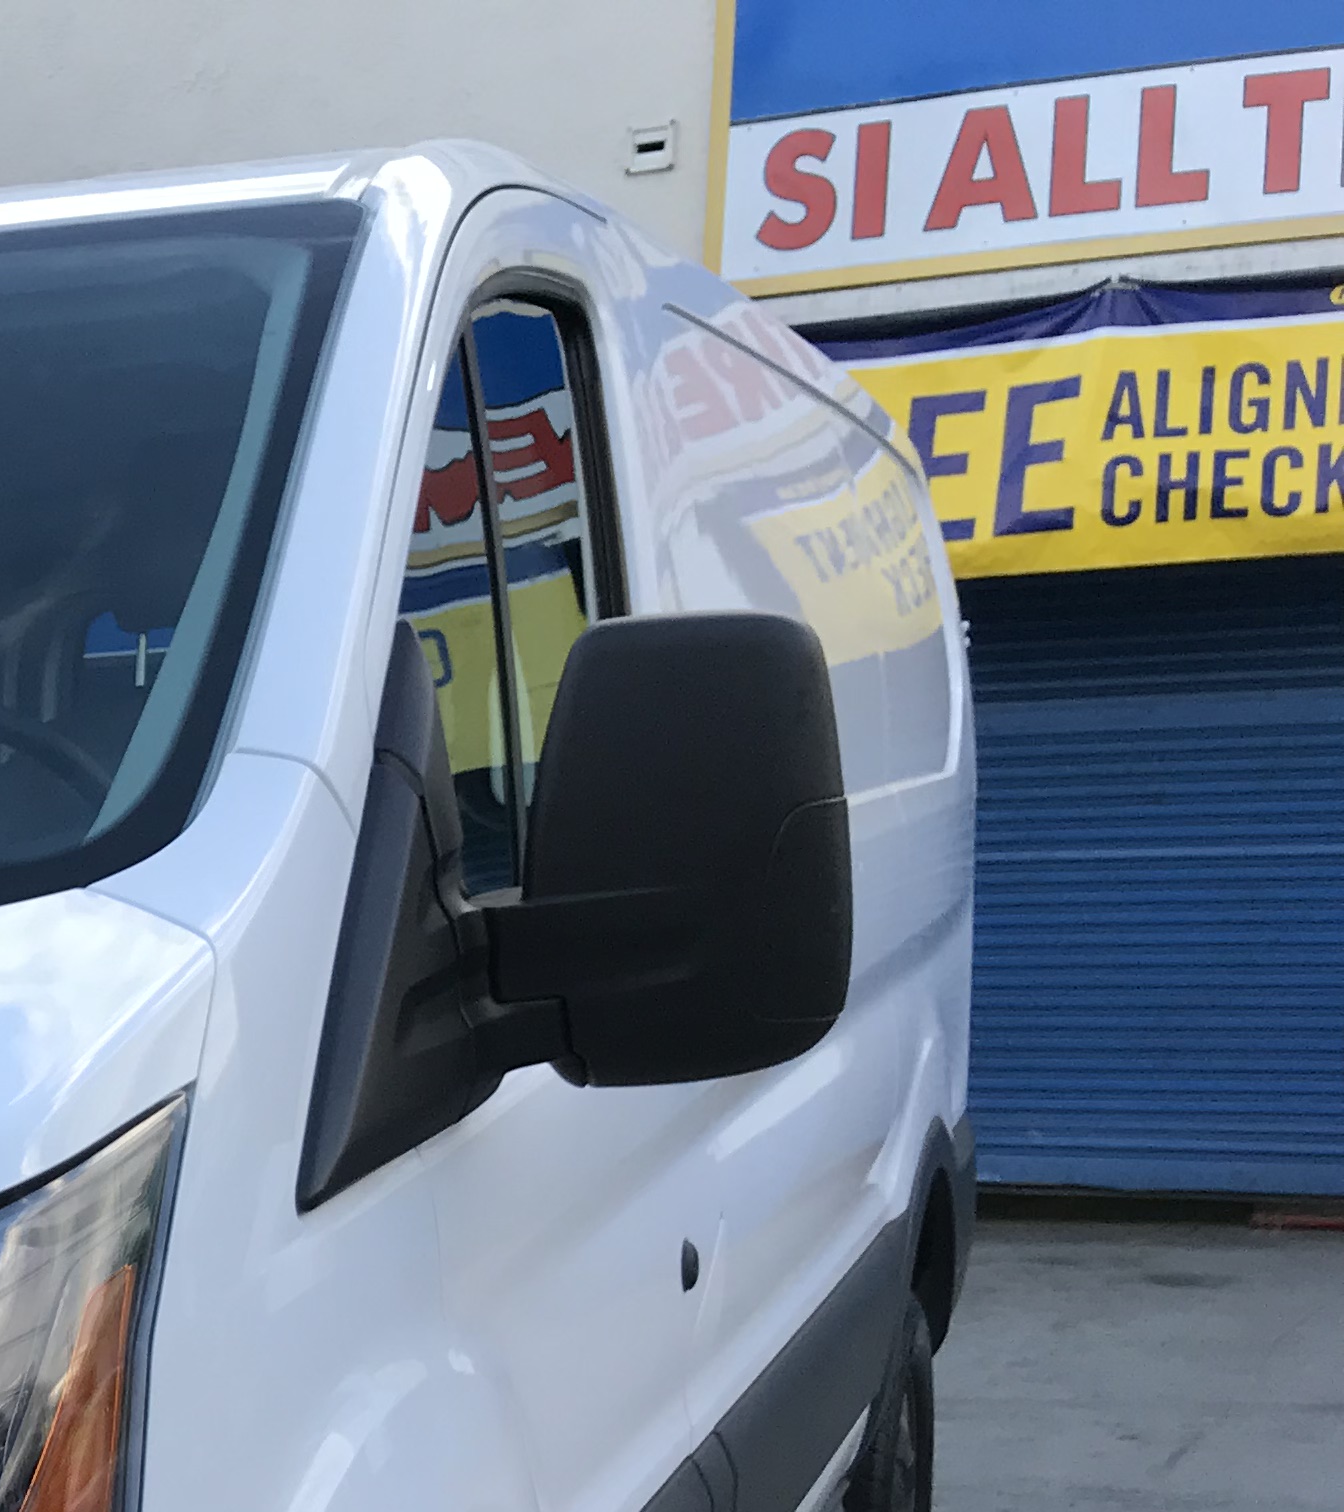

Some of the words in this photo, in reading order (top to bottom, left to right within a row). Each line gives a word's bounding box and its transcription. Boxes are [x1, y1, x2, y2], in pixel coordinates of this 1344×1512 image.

[756, 120, 892, 250] SI
[923, 85, 1210, 232] ALL
[1243, 67, 1344, 194] T
[1100, 355, 1344, 441] ALIGN
[1100, 442, 1344, 527] CHECK
